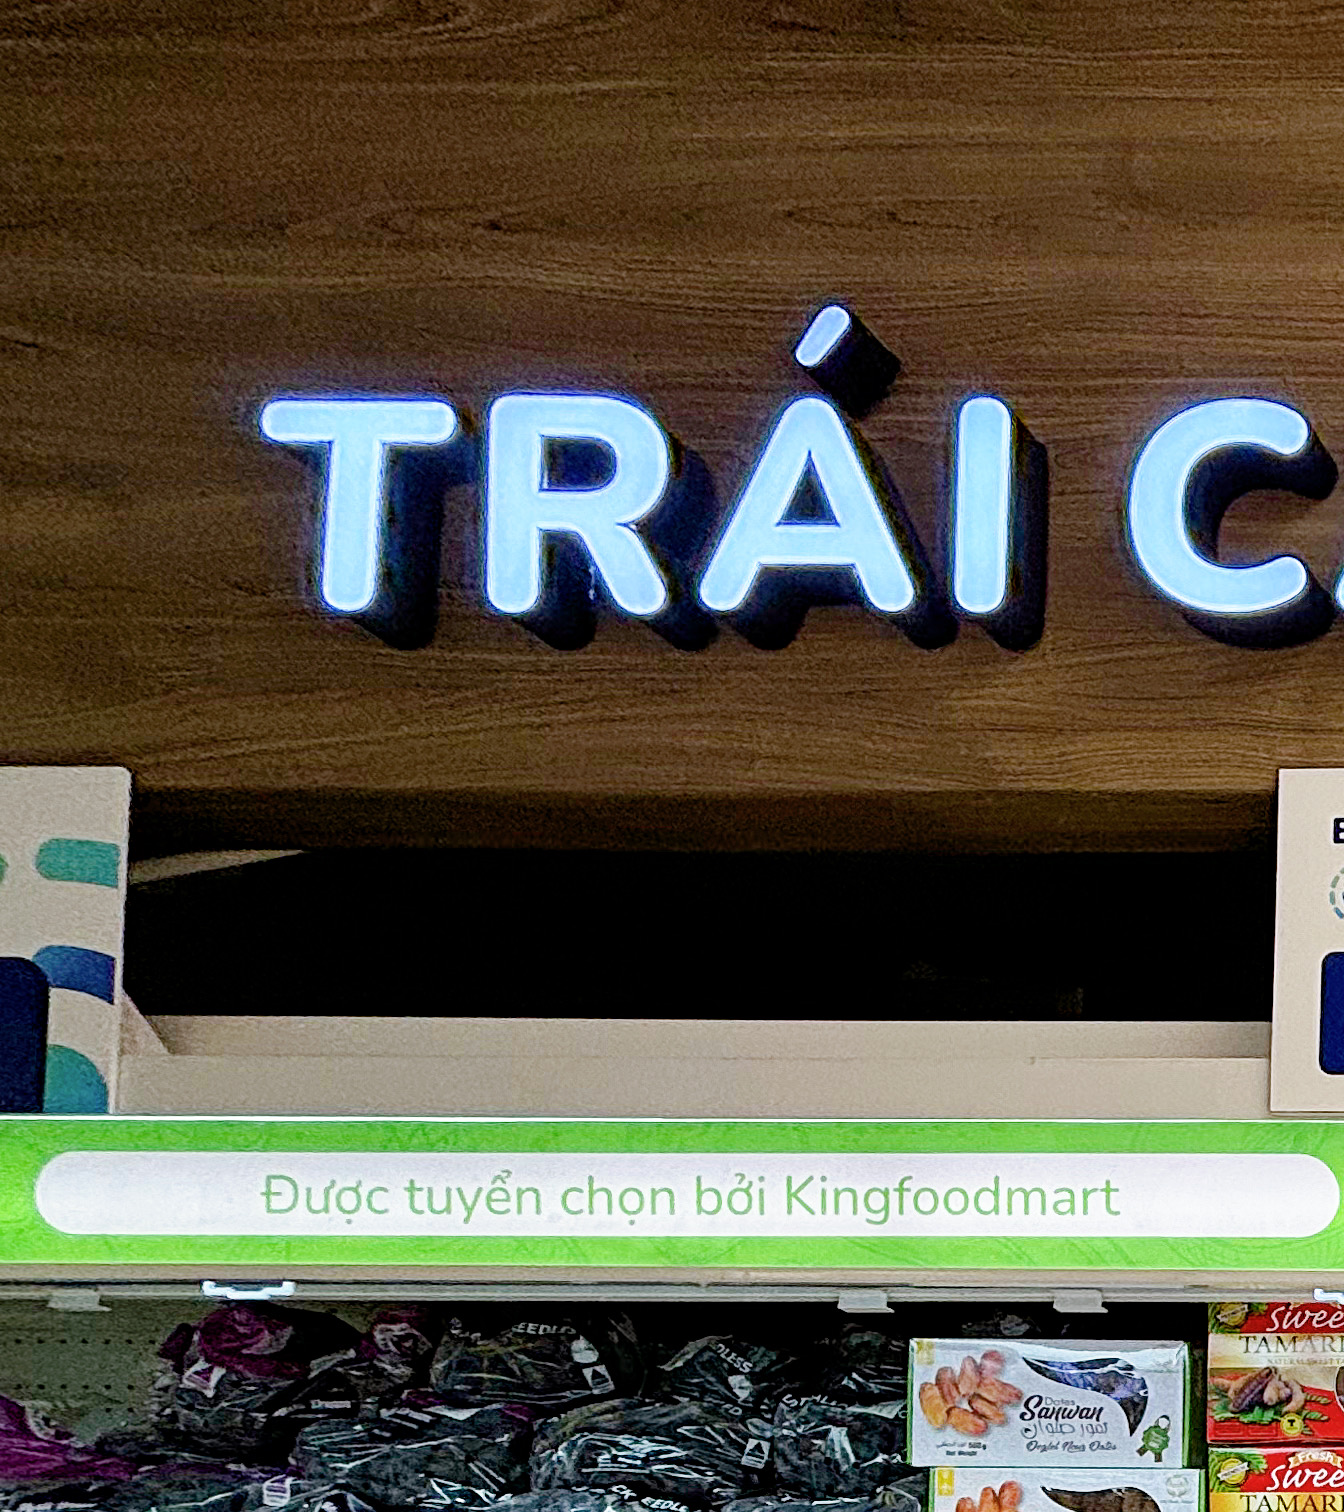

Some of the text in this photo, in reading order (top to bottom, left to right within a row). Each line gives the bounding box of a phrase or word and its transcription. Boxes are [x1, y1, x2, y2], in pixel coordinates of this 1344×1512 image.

[260, 303, 1015, 618] TRÁI
[260, 1168, 1122, 1227] Được tuyển chọn bởi Kingfoodmart
